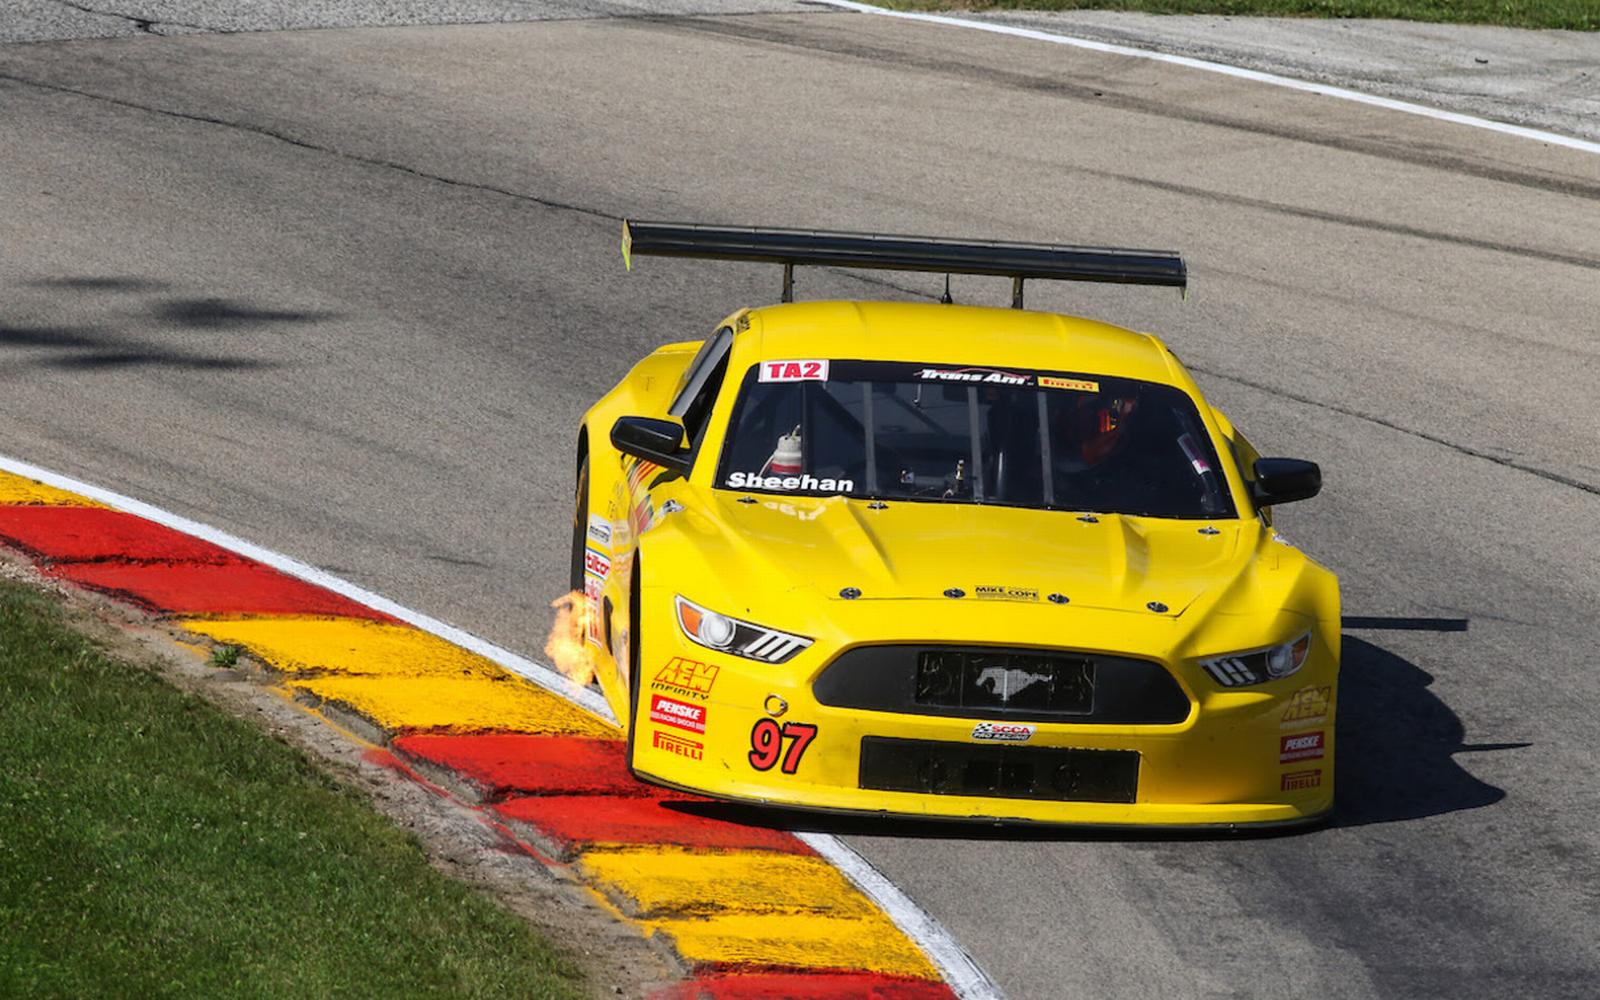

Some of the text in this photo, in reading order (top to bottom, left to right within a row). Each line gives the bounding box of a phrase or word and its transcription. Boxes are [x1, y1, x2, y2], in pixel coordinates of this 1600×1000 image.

[767, 362, 822, 379] TA2
[920, 368, 1025, 386] Trans Am
[728, 472, 854, 492] Sheehan
[653, 656, 721, 694] AEM
[651, 681, 709, 700] INFINITY
[656, 699, 702, 721] PENSKE
[992, 725, 1030, 733] SCCA
[653, 730, 704, 761] PIRELLI
[748, 717, 818, 775] 97
[1284, 735, 1320, 751] PENSKE
[1280, 768, 1322, 792] PIRELLI
